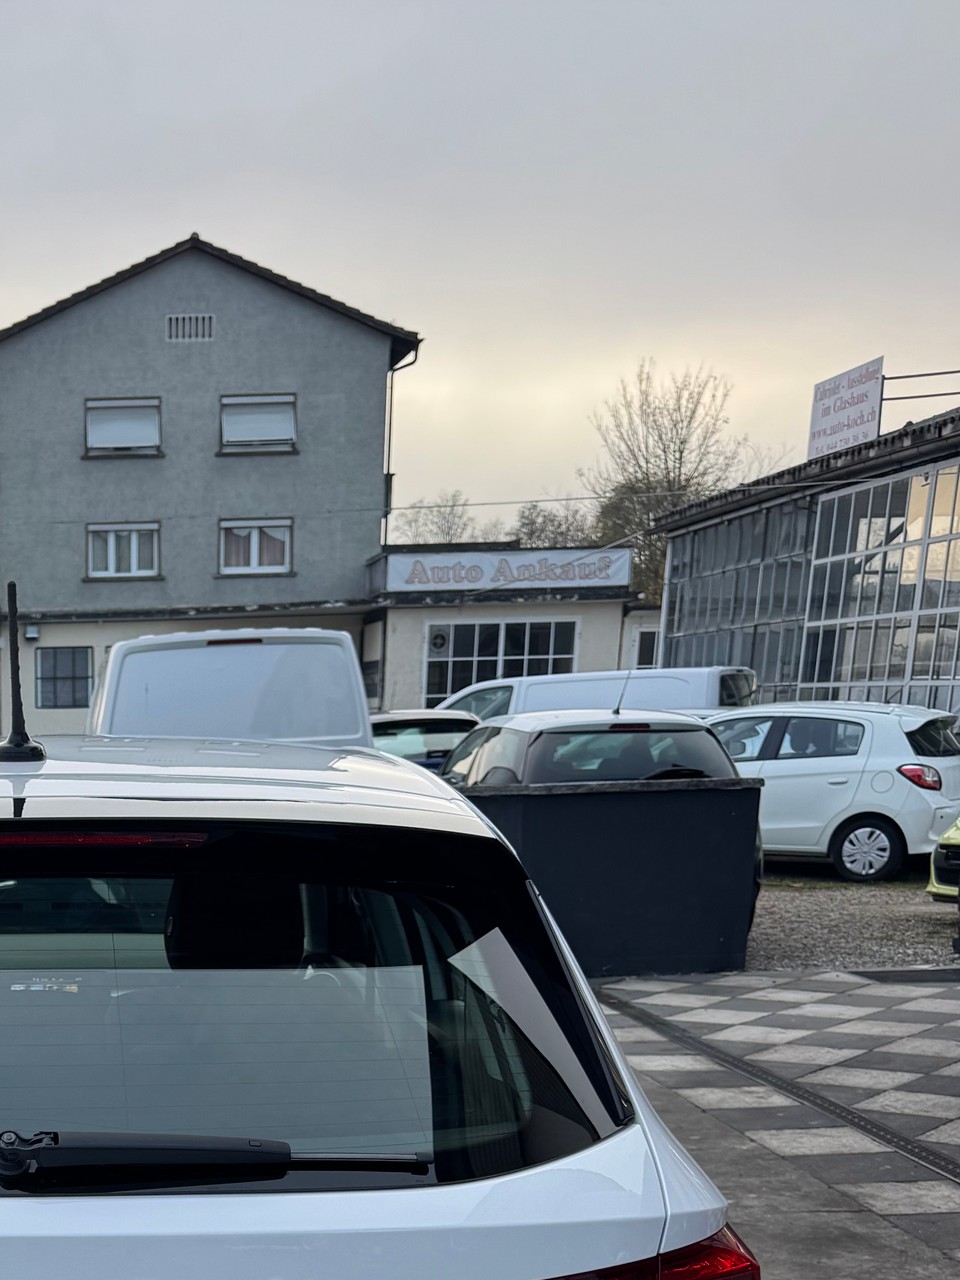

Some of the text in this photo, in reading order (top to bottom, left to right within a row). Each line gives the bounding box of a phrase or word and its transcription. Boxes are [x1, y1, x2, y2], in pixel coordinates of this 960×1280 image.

[821, 391, 869, 418] im Glashaus
[404, 556, 613, 584] Auto Ankauf
